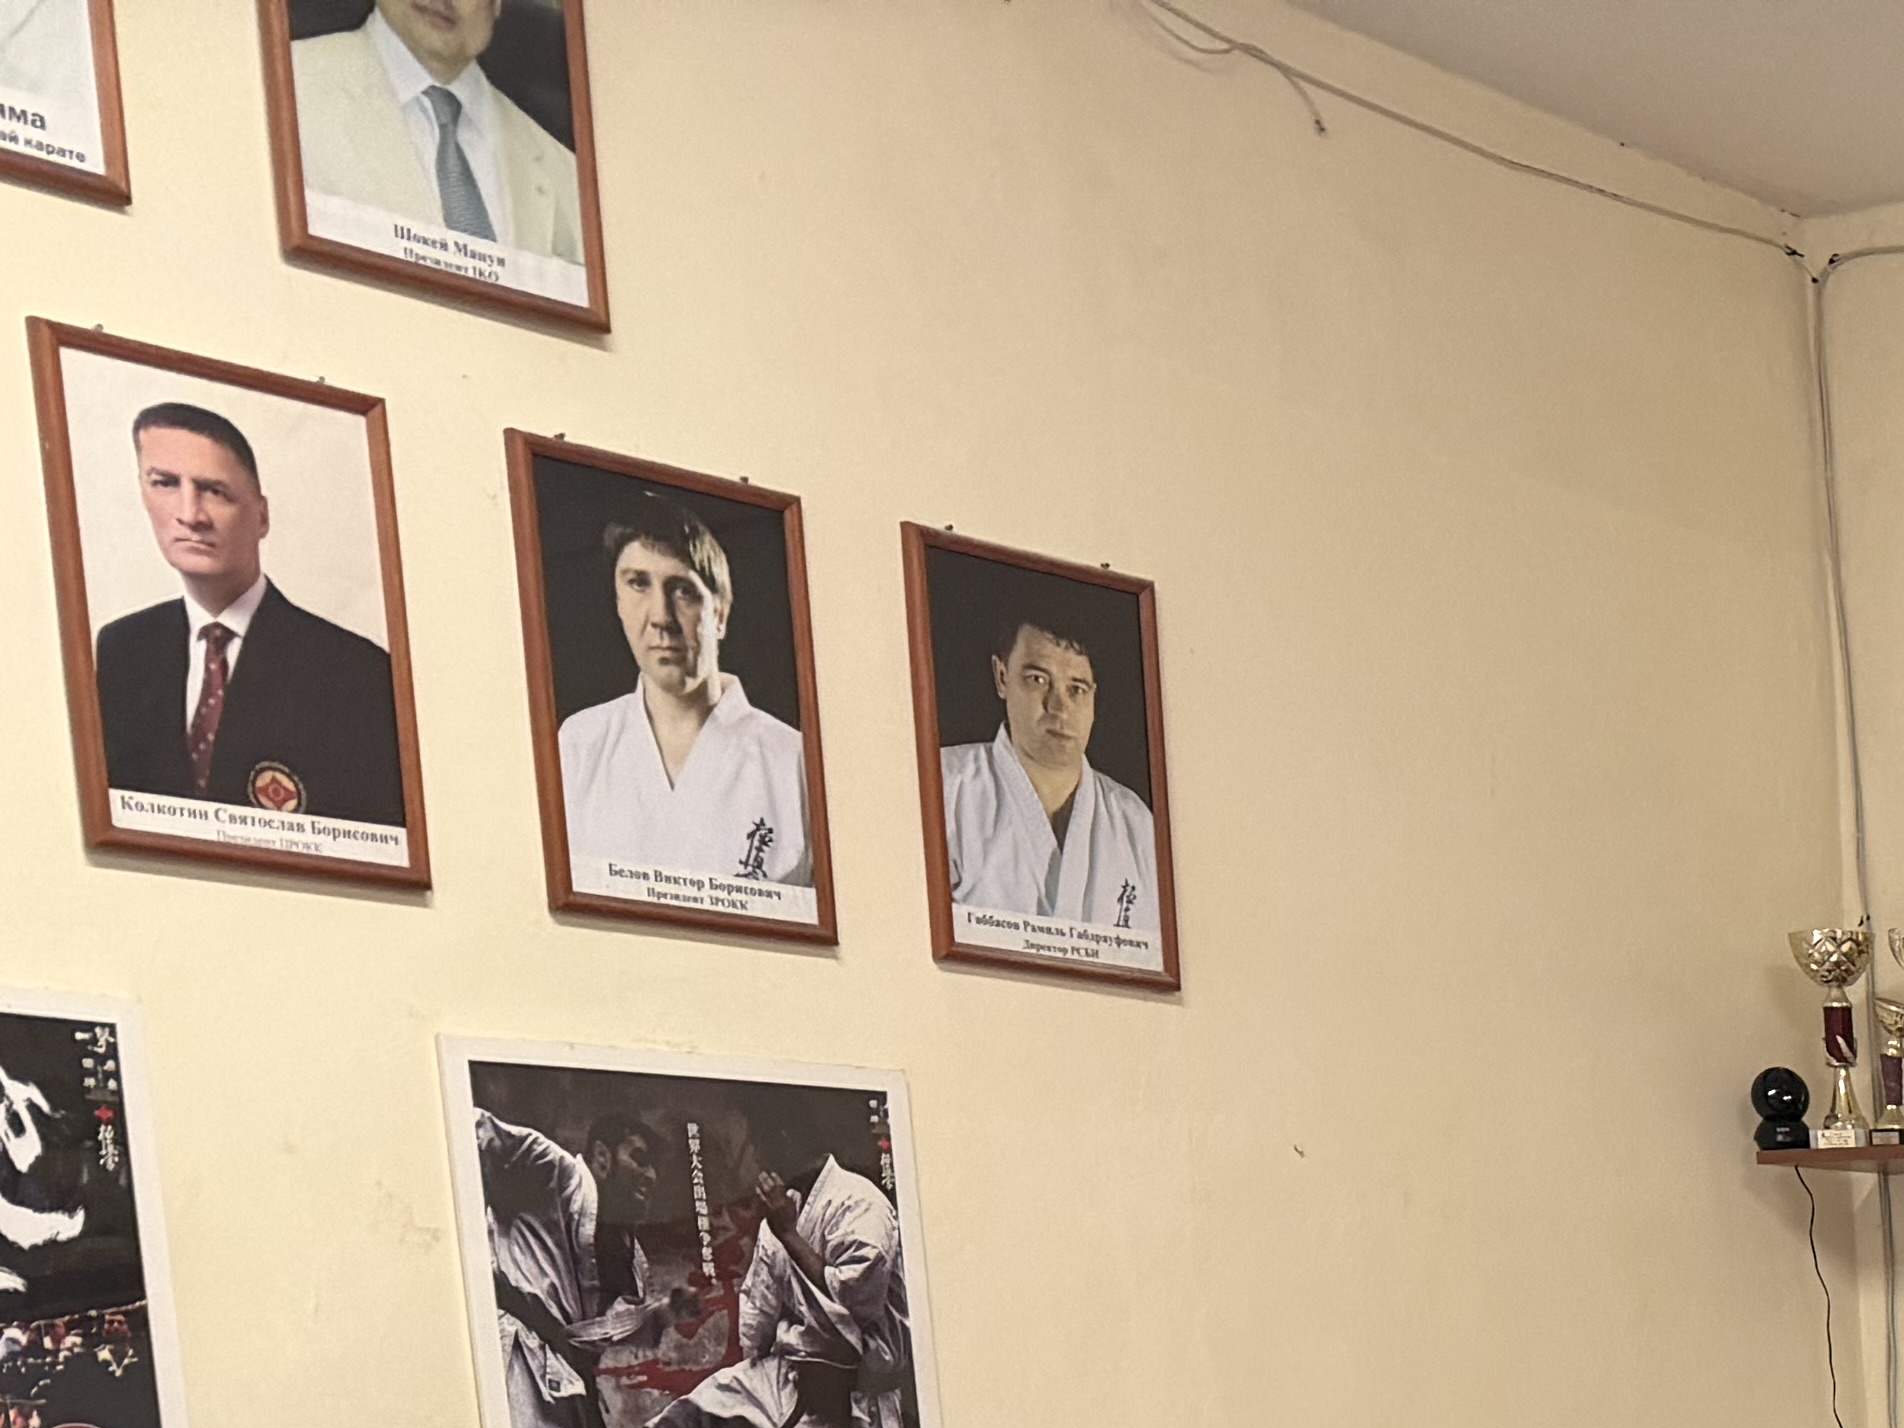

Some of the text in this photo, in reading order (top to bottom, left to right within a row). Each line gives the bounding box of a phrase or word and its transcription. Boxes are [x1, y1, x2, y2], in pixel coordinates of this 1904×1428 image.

[120, 795, 400, 847] Колкотин Святослав Борисович
[608, 862, 782, 901] Белов Виктор Борисович
